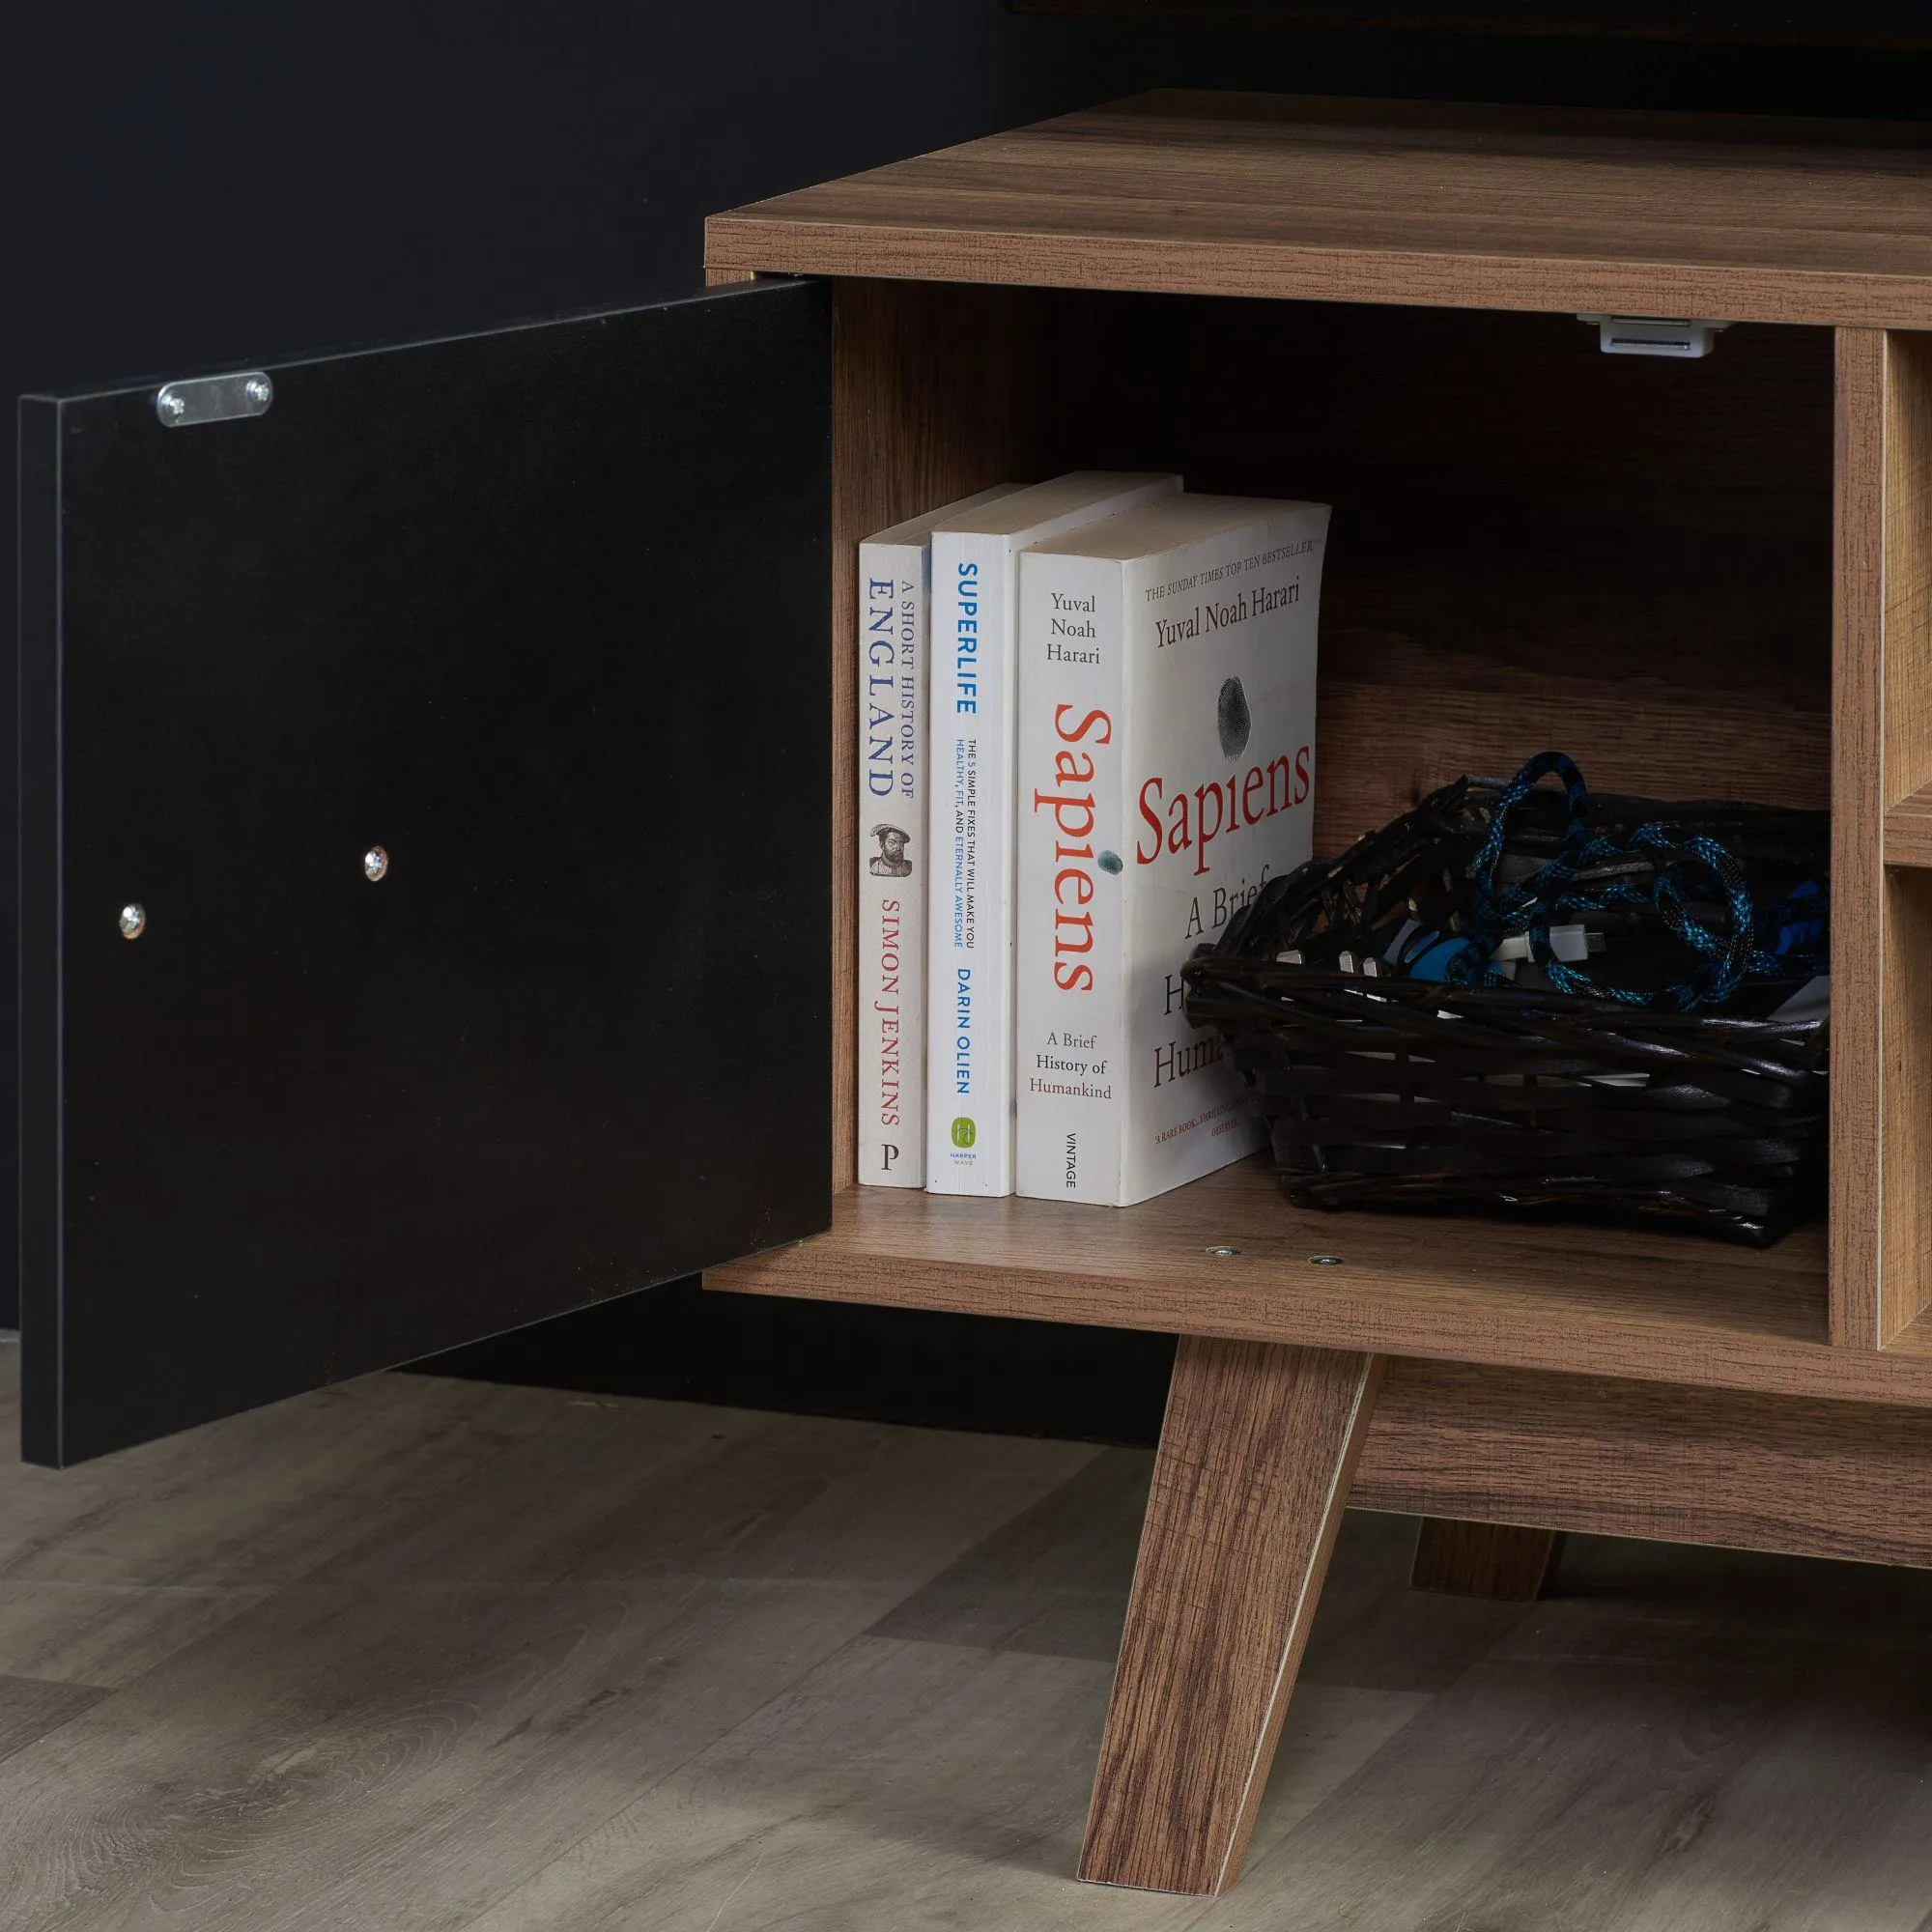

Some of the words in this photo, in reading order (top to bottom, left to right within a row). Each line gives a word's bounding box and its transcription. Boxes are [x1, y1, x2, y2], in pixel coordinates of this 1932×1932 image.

[901, 581, 915, 593] A
[1146, 584, 1165, 602] THE
[1167, 574, 1198, 597] SUNDAY
[1199, 567, 1224, 587] TIMES
[1225, 559, 1243, 578] TOP
[1243, 554, 1261, 572] TEN
[1262, 539, 1314, 566] BESTSELLER
[1050, 592, 1096, 614] Yuval
[1155, 609, 1201, 648] Yuval
[1205, 593, 1248, 633] Noah
[1252, 576, 1300, 617] Harari
[900, 601, 915, 668] SHORT
[956, 562, 979, 714] SUPERLIFE
[1050, 618, 1096, 639] Noah
[1046, 643, 1100, 665] Harari
[867, 579, 895, 797] ENGLAND
[900, 677, 915, 766] HISTORY
[954, 739, 965, 787] HEALTHY,
[967, 739, 977, 760] THE
[900, 773, 915, 799] OF
[954, 790, 965, 808] FIT,
[967, 770, 976, 807] SIMPLE
[954, 810, 964, 834] AND
[967, 810, 976, 838] FIXES
[1136, 745, 1310, 876] Sapiens
[954, 836, 964, 893] ETERNALLY
[967, 839, 976, 866] THAT
[1034, 703, 1112, 992] Sapiens
[966, 868, 976, 892] WILL
[954, 895, 964, 948] AWESOME
[966, 894, 975, 924] MAKE
[1184, 896, 1205, 939] A
[881, 898, 900, 995] SIMON
[966, 924, 975, 949] YOU
[957, 968, 971, 1030] DARIN
[1047, 1032, 1059, 1046] A
[1063, 1032, 1097, 1050] Brief
[874, 1000, 900, 1127] JENKINS
[956, 1036, 971, 1094] OLIEN
[1036, 1053, 1089, 1076] History
[1092, 1059, 1108, 1074] of
[1029, 1078, 1113, 1099] Humankind
[881, 1143, 899, 1171] P
[1065, 1132, 1077, 1189] VINTAGE
